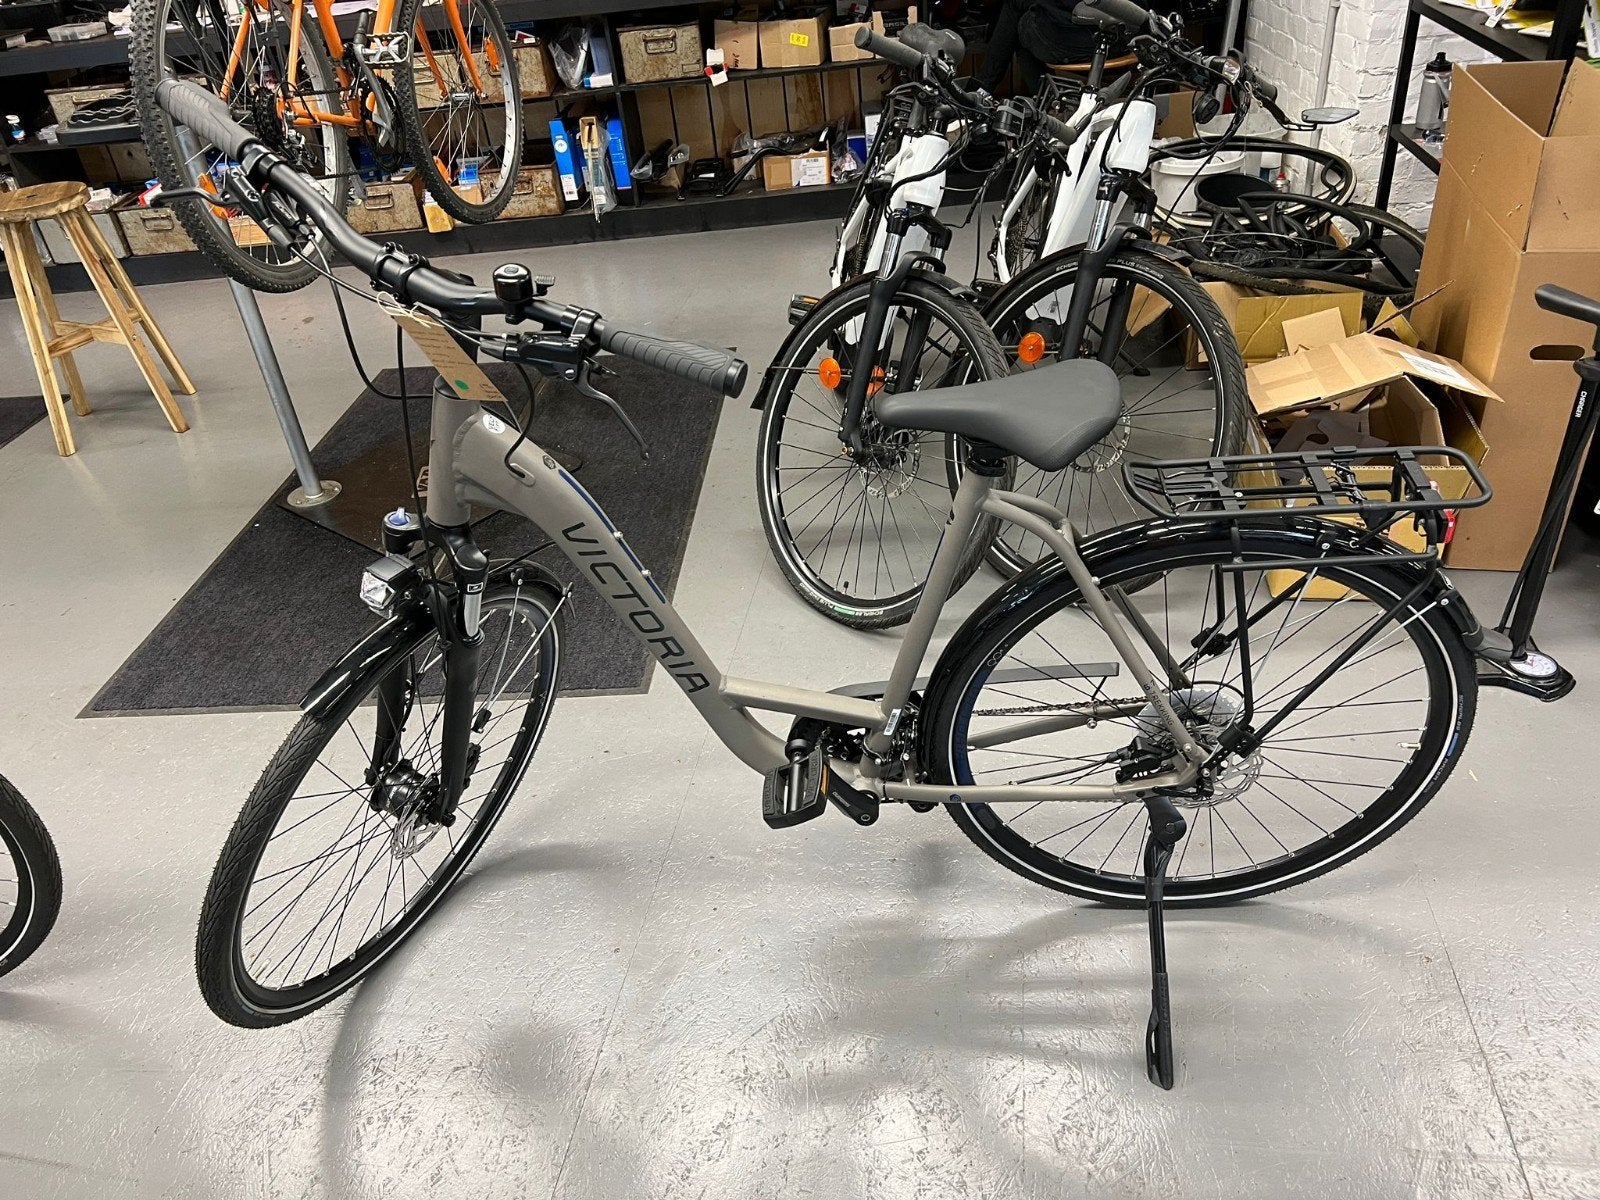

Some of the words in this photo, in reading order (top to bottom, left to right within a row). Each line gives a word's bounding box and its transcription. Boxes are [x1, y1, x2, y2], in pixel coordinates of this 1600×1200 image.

[1575, 391, 1587, 418] CHARGER
[561, 522, 711, 693] VICTORIA
[1151, 691, 1174, 726] TREKKING
